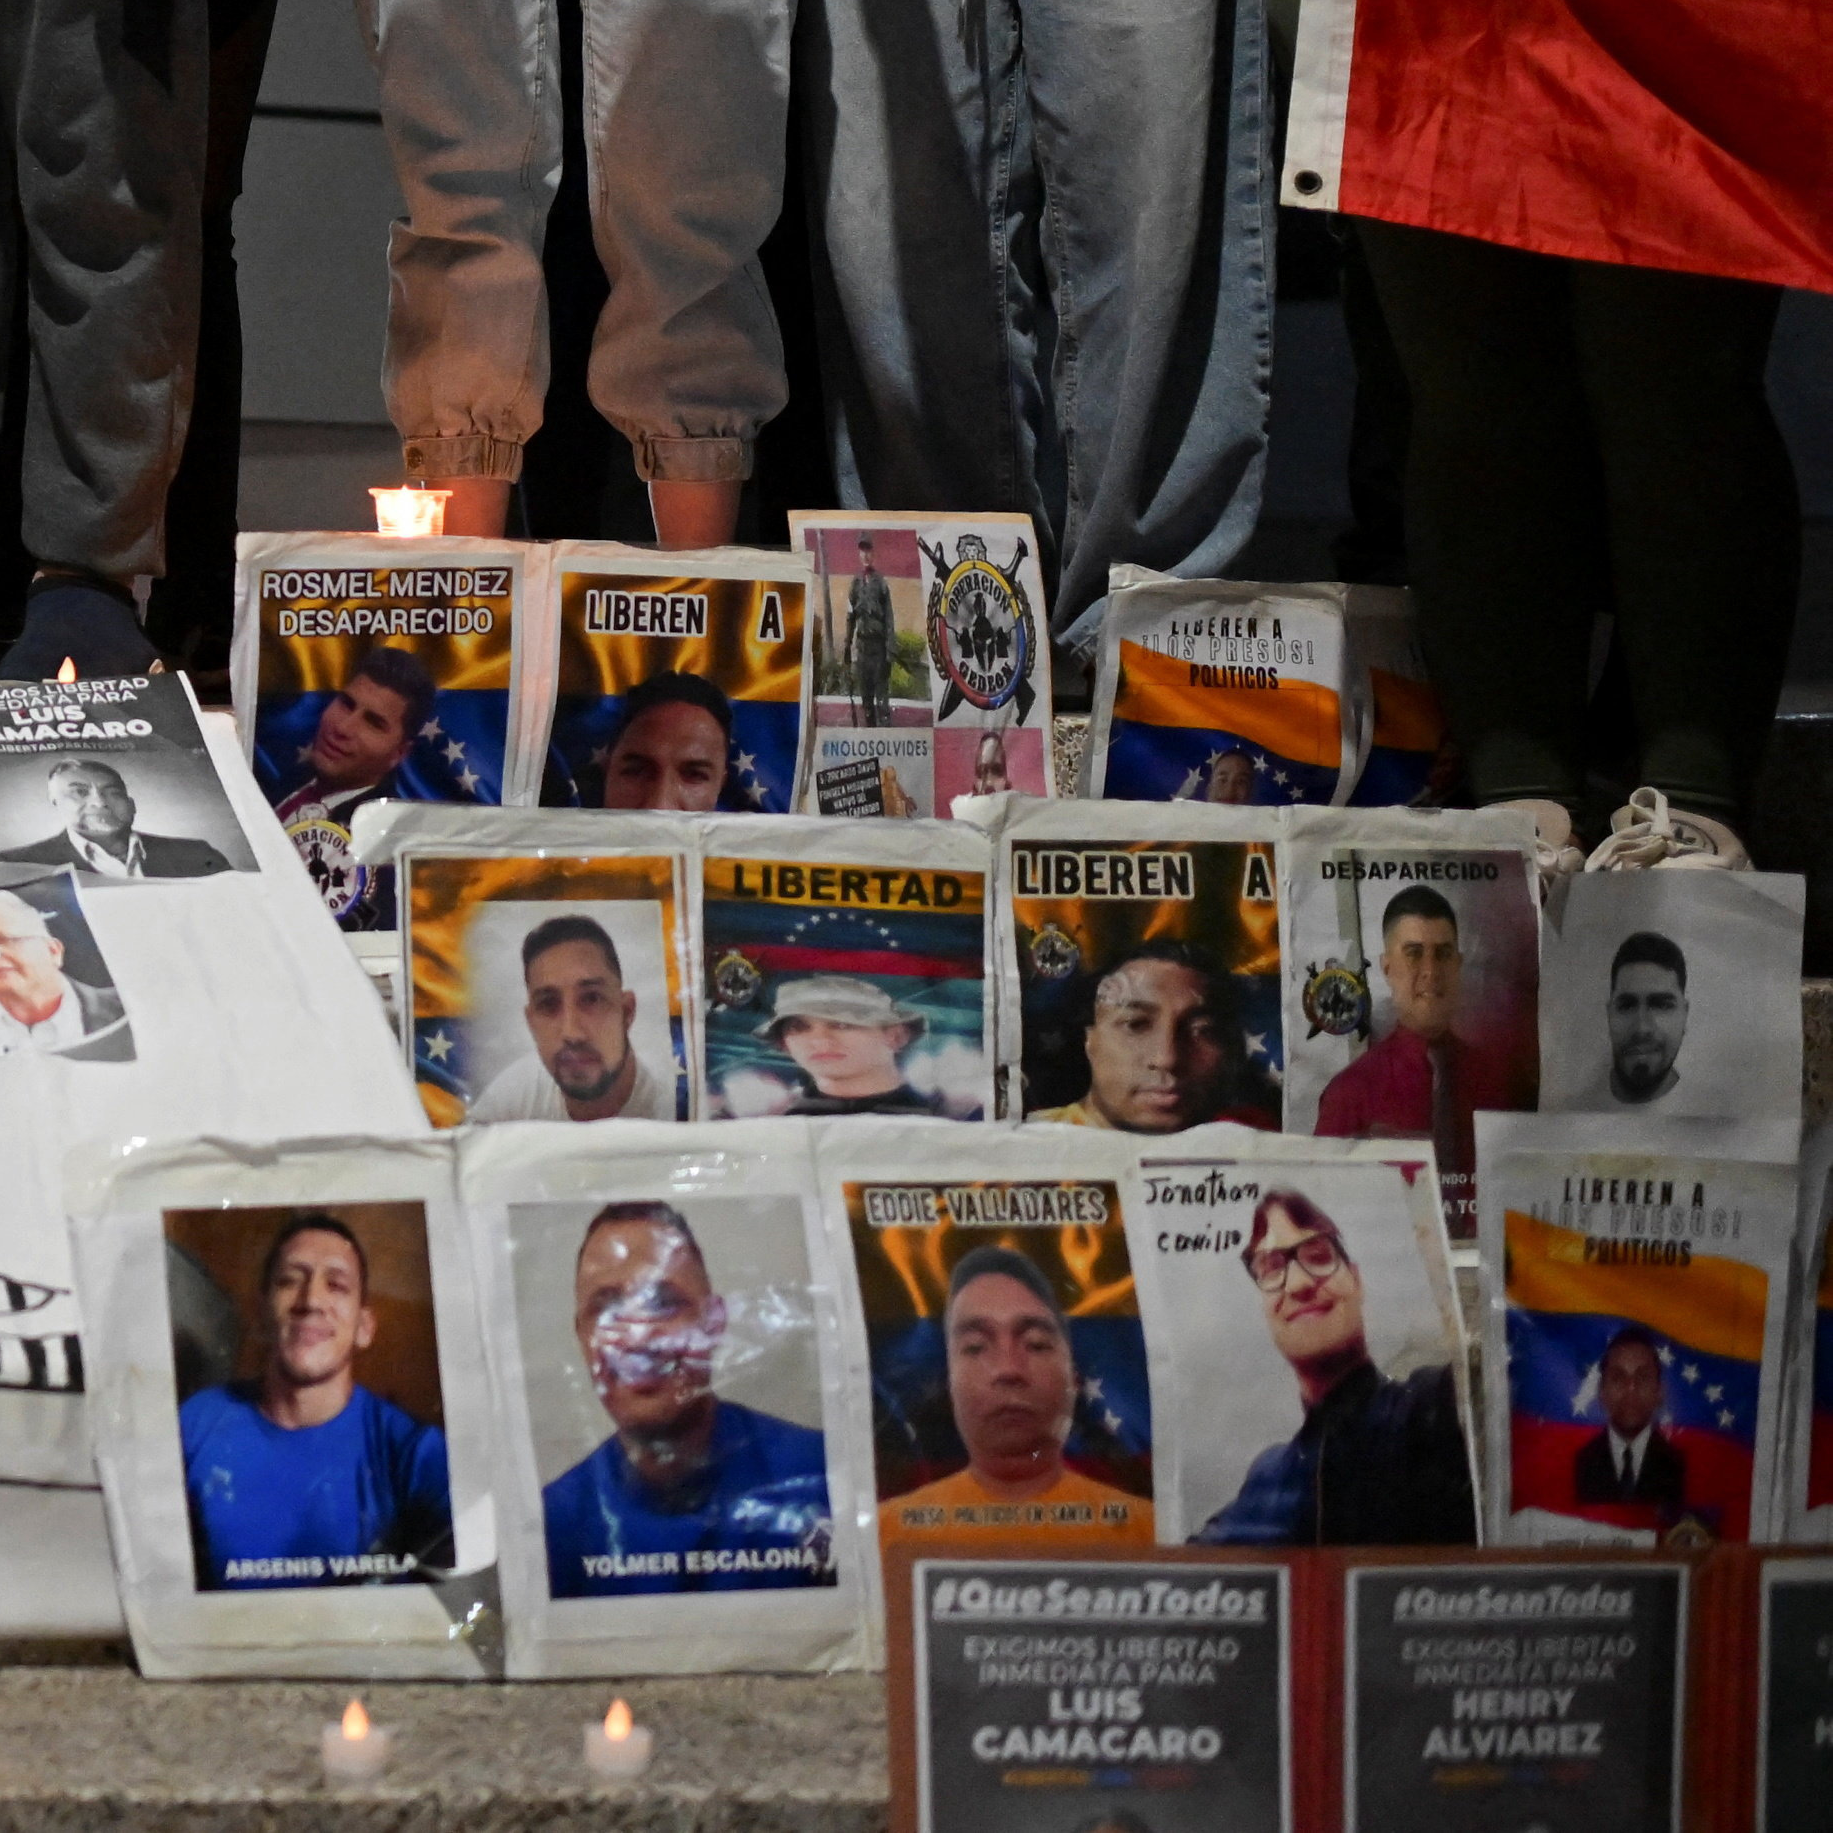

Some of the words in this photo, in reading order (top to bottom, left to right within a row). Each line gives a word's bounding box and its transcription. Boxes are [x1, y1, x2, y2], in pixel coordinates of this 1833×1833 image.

[262, 571, 382, 599] ROSMEL
[390, 570, 508, 597] MENDEZ
[948, 572, 1011, 615] OPERACION
[279, 607, 493, 637] DESAPARECIDO
[586, 589, 708, 637] LIBEREN
[759, 591, 785, 642] A
[1172, 617, 1257, 638] LIBEREN
[1273, 619, 1282, 639] A
[1210, 638, 1314, 664] PRESOS!
[46, 678, 150, 696] LIBERTAD
[78, 691, 137, 704] PARA
[11, 705, 86, 725] LUIS
[822, 740, 927, 757] #NOLOSOLVIDES
[734, 861, 963, 908] LIBERTAD
[1013, 851, 1194, 900] LIBEREN
[1243, 852, 1273, 901] A
[1320, 860, 1500, 882] DESAPARECIDO
[1143, 1170, 1260, 1206] Jonathan
[1564, 1178, 1674, 1208] LIBEREN
[1691, 1180, 1704, 1208] A
[865, 1185, 938, 1226] EDDIE
[948, 1185, 1108, 1226] VALLADARES
[225, 1556, 324, 1582] ARGENIS
[329, 1551, 418, 1576] VARELA
[584, 1554, 681, 1577] YOLMER
[687, 1548, 819, 1572] ESCALONA
[933, 1578, 1267, 1623] #QueSeanTodos
[1048, 1688, 1144, 1723] LUIS
[1453, 1688, 1577, 1721] HENRY
[971, 1725, 1222, 1761] CAMACARO
[1421, 1722, 1604, 1760] ALVIAREZ
